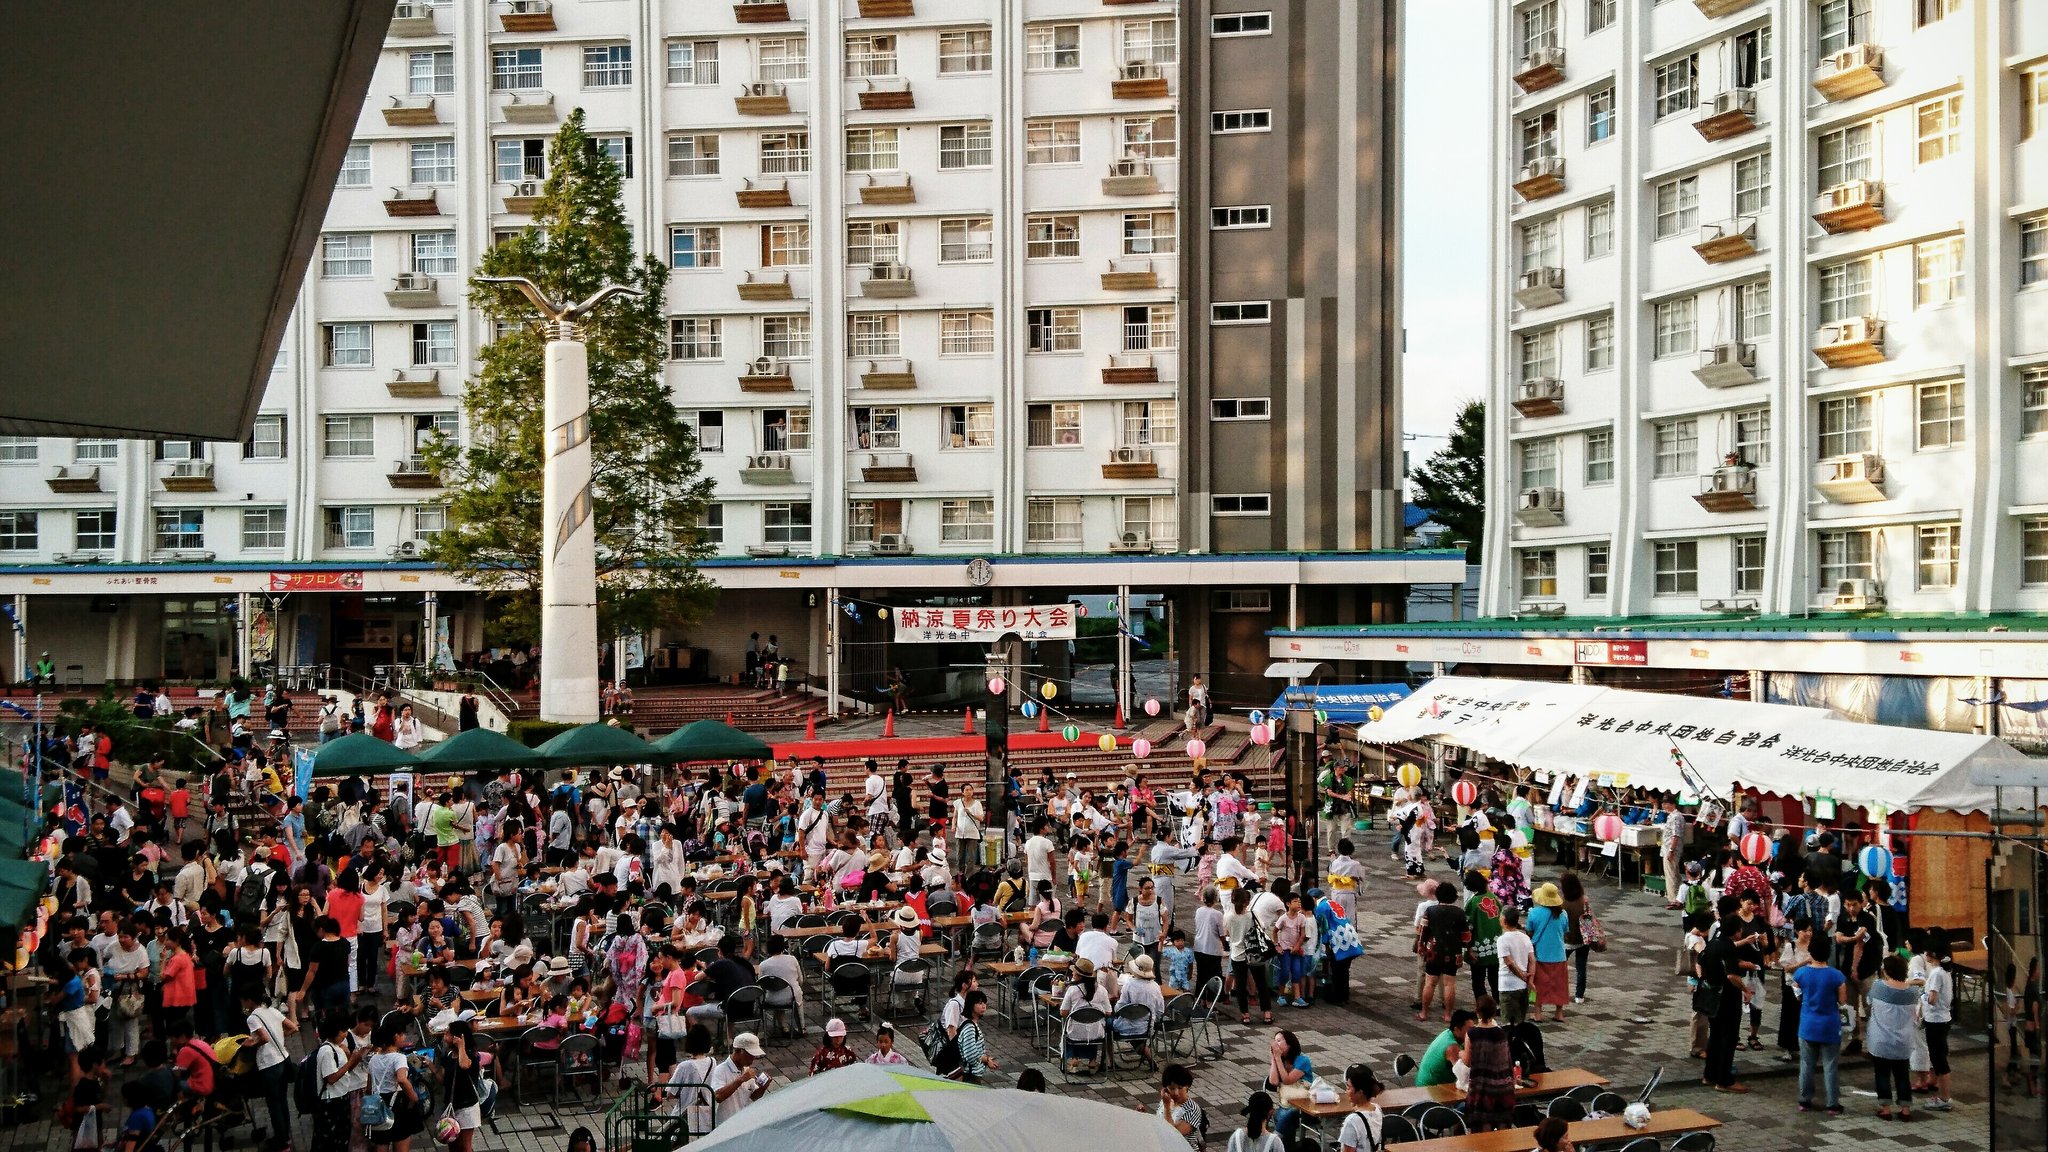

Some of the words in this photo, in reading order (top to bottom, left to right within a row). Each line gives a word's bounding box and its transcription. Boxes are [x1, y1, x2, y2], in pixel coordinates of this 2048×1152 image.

[106, 577, 158, 585] ふれあい整骨院
[291, 574, 339, 585] サフロン
[901, 608, 1068, 629] 納涼夏祭り大会
[1576, 712, 1782, 749] 洋光台中央団地自治会
[1780, 744, 1940, 776] 洋光台中央団地自治会
